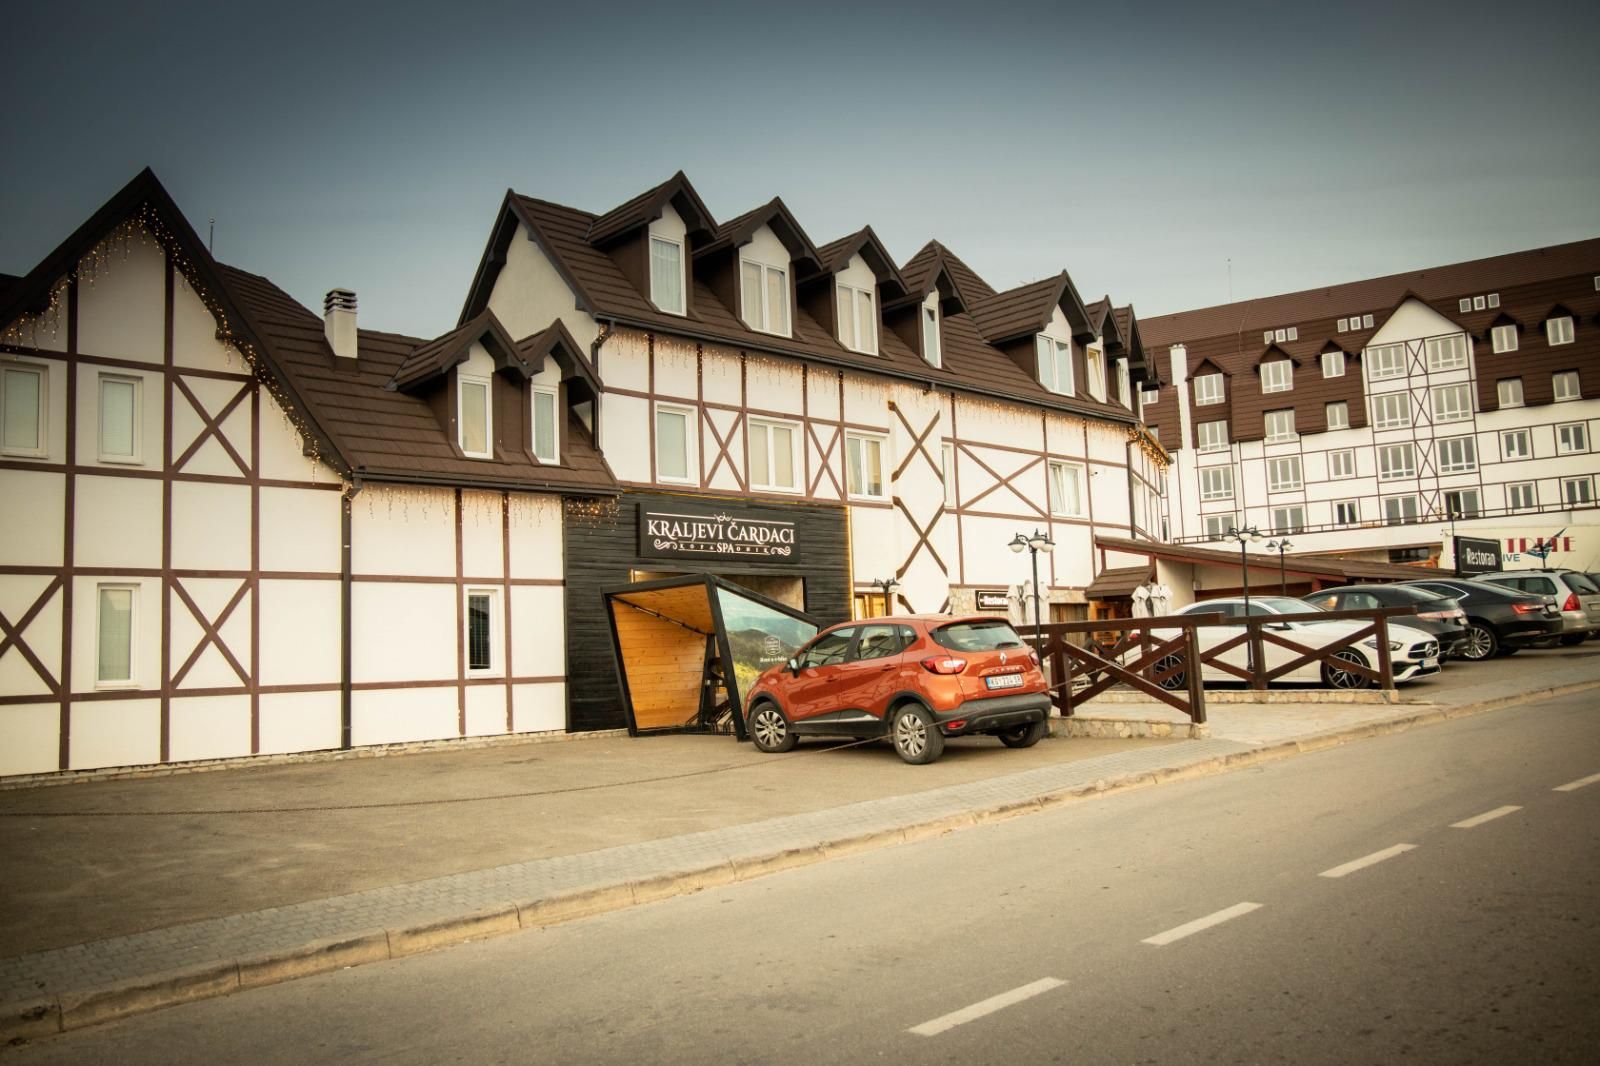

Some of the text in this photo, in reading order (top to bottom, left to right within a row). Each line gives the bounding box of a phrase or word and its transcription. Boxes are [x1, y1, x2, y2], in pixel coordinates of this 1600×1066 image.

[647, 519, 795, 545] KRALJEVI ČARDACI
[716, 542, 734, 554] SPA
[1466, 547, 1496, 566] Restoran
[984, 596, 1008, 605] Restora
